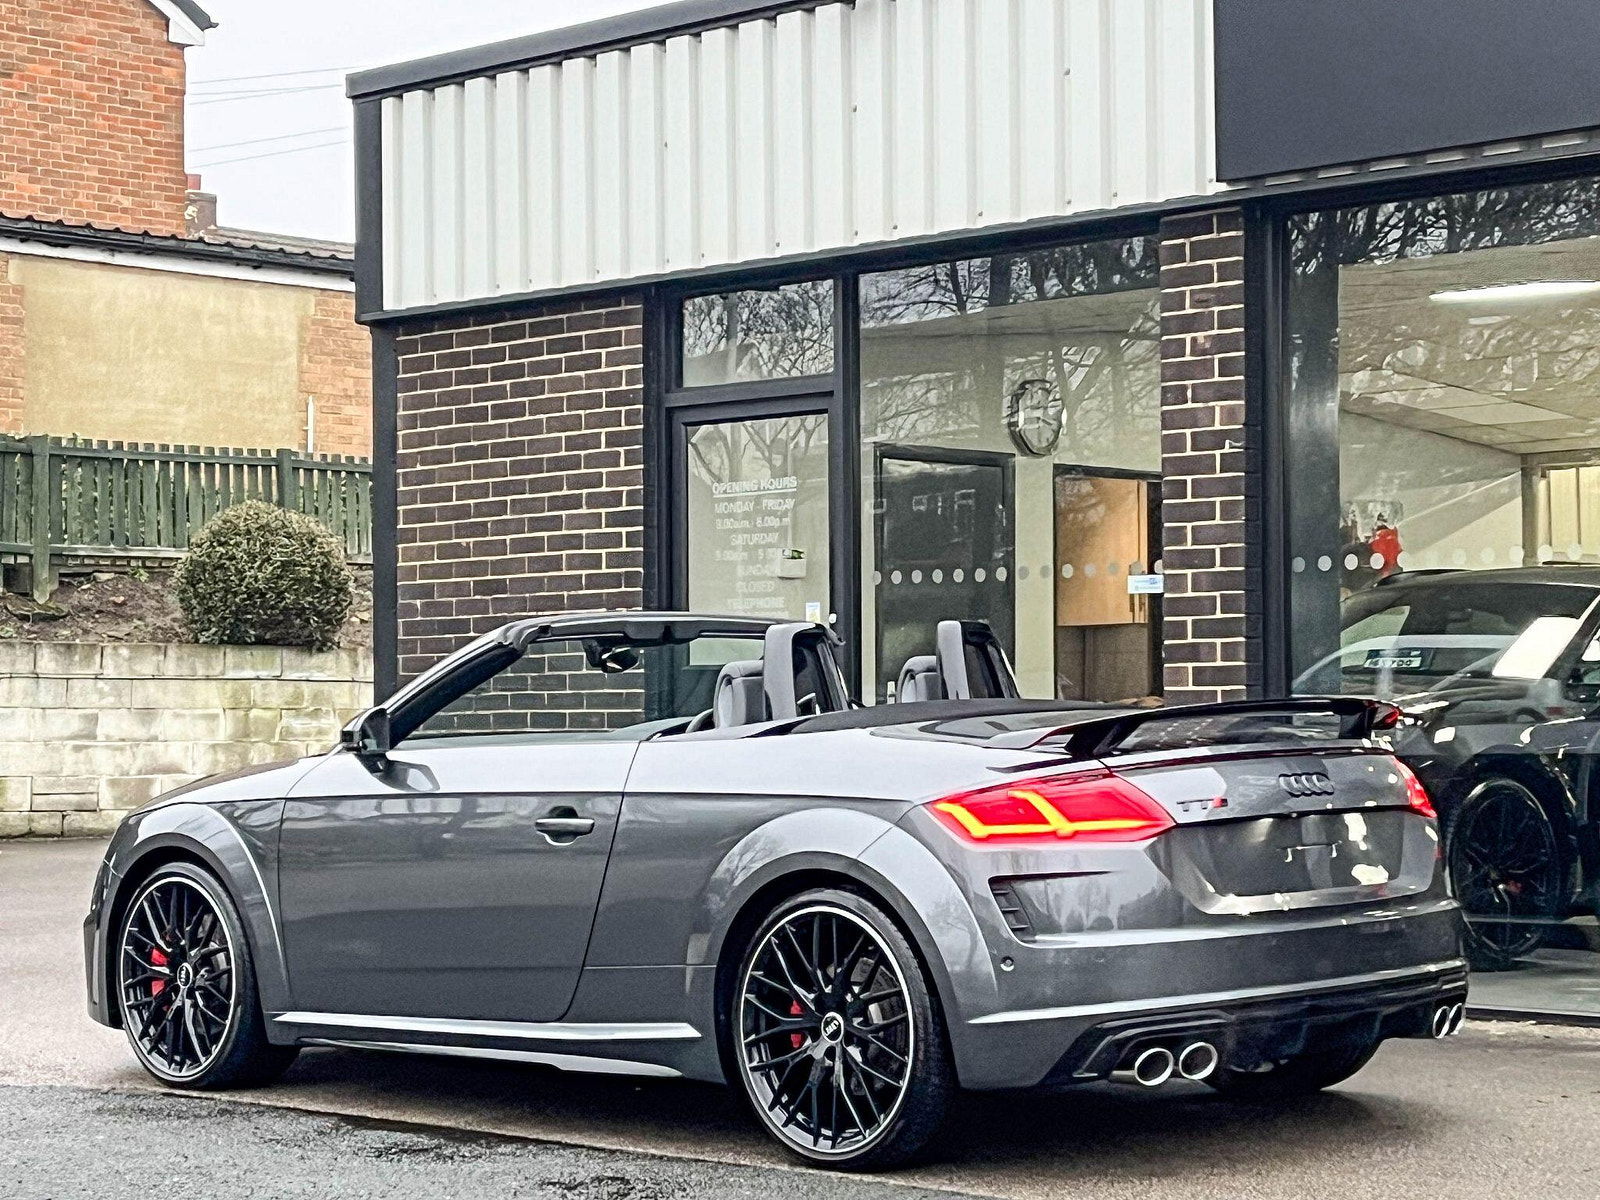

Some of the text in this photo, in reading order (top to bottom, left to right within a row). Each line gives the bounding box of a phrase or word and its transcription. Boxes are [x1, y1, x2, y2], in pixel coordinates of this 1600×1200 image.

[712, 475, 798, 494] OPENING HOURS
[714, 500, 755, 513] MONDAY
[762, 498, 796, 511] FRIDAY
[731, 533, 779, 545] SATURDAY
